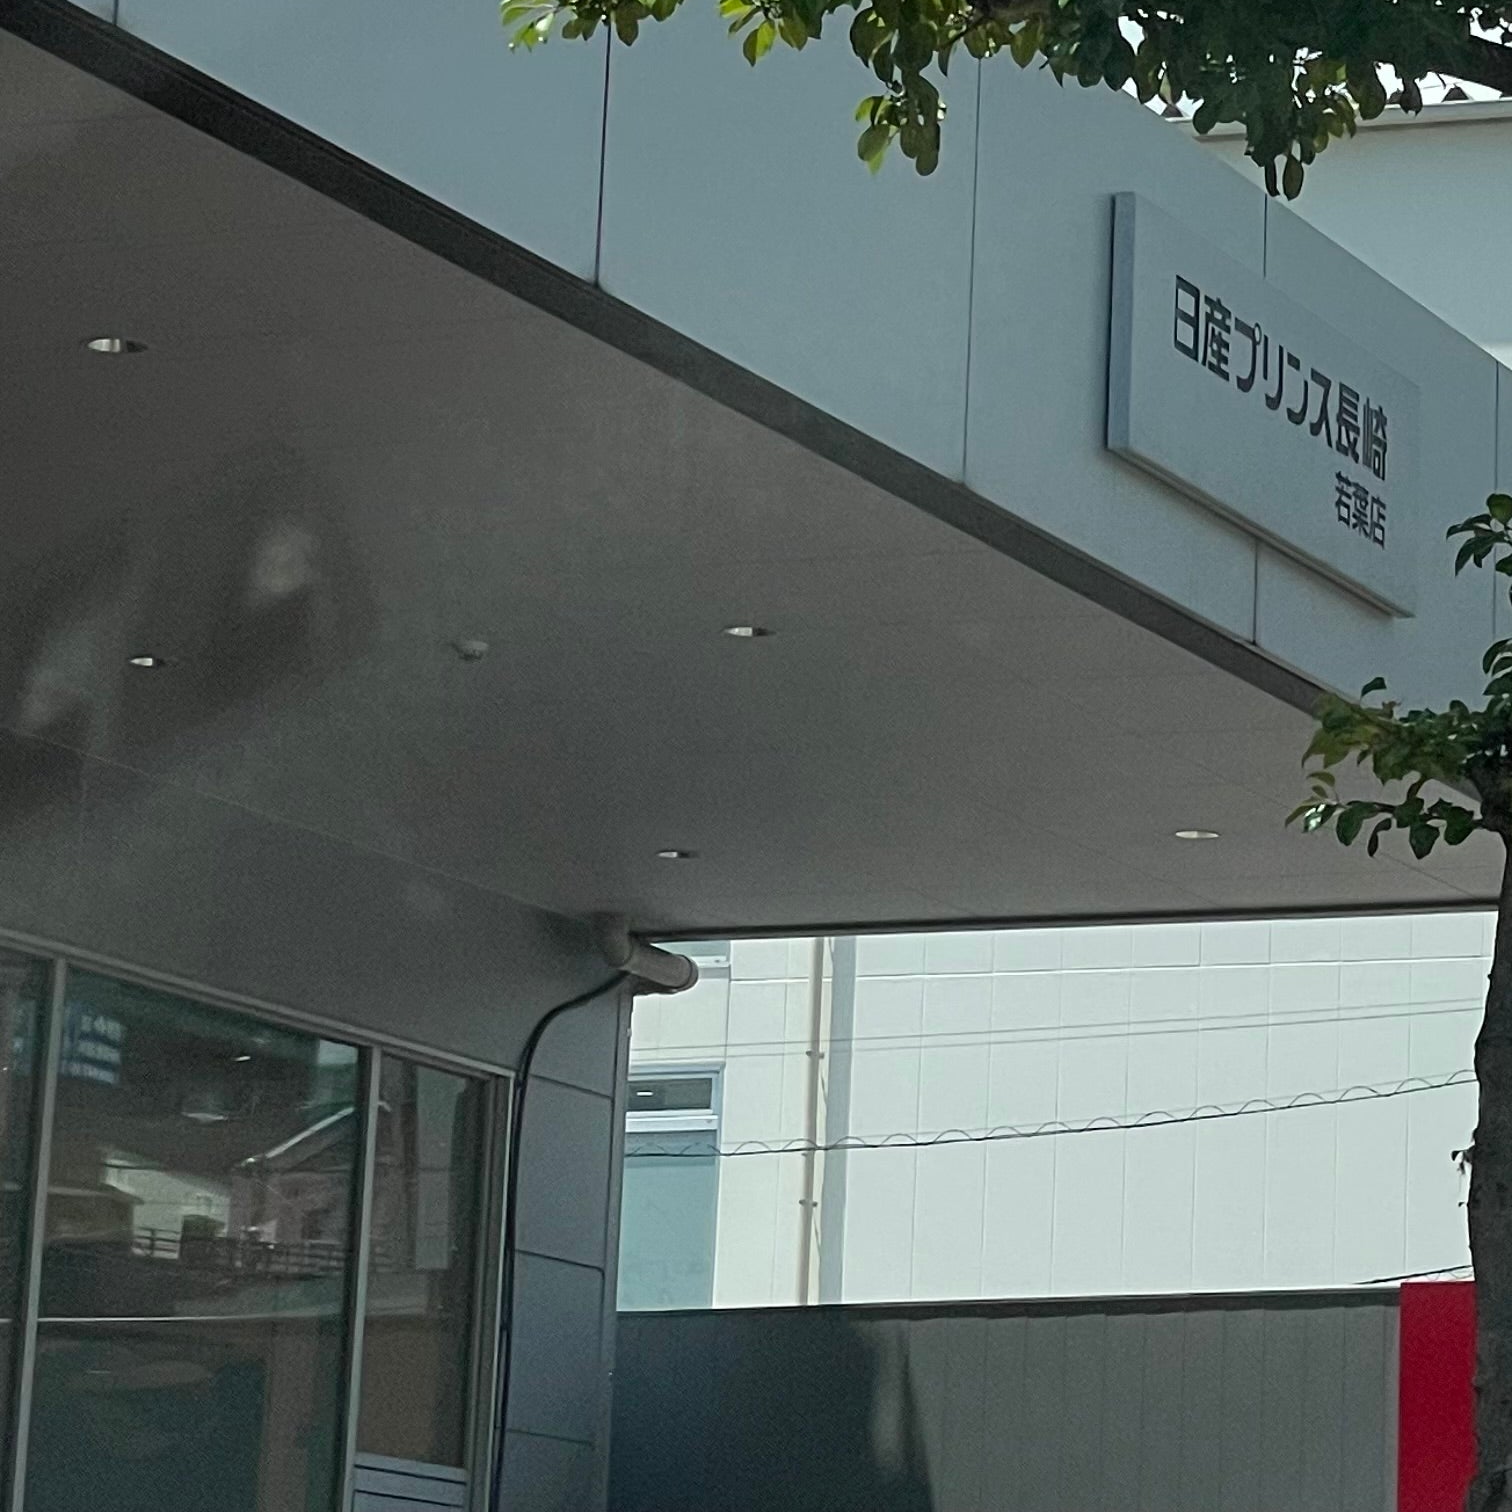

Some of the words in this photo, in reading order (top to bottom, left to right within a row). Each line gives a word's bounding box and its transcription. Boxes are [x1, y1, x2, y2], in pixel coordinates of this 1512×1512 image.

[1174, 274, 1388, 482] 日産プリンス長崎
[1334, 471, 1387, 549] 若葉店
